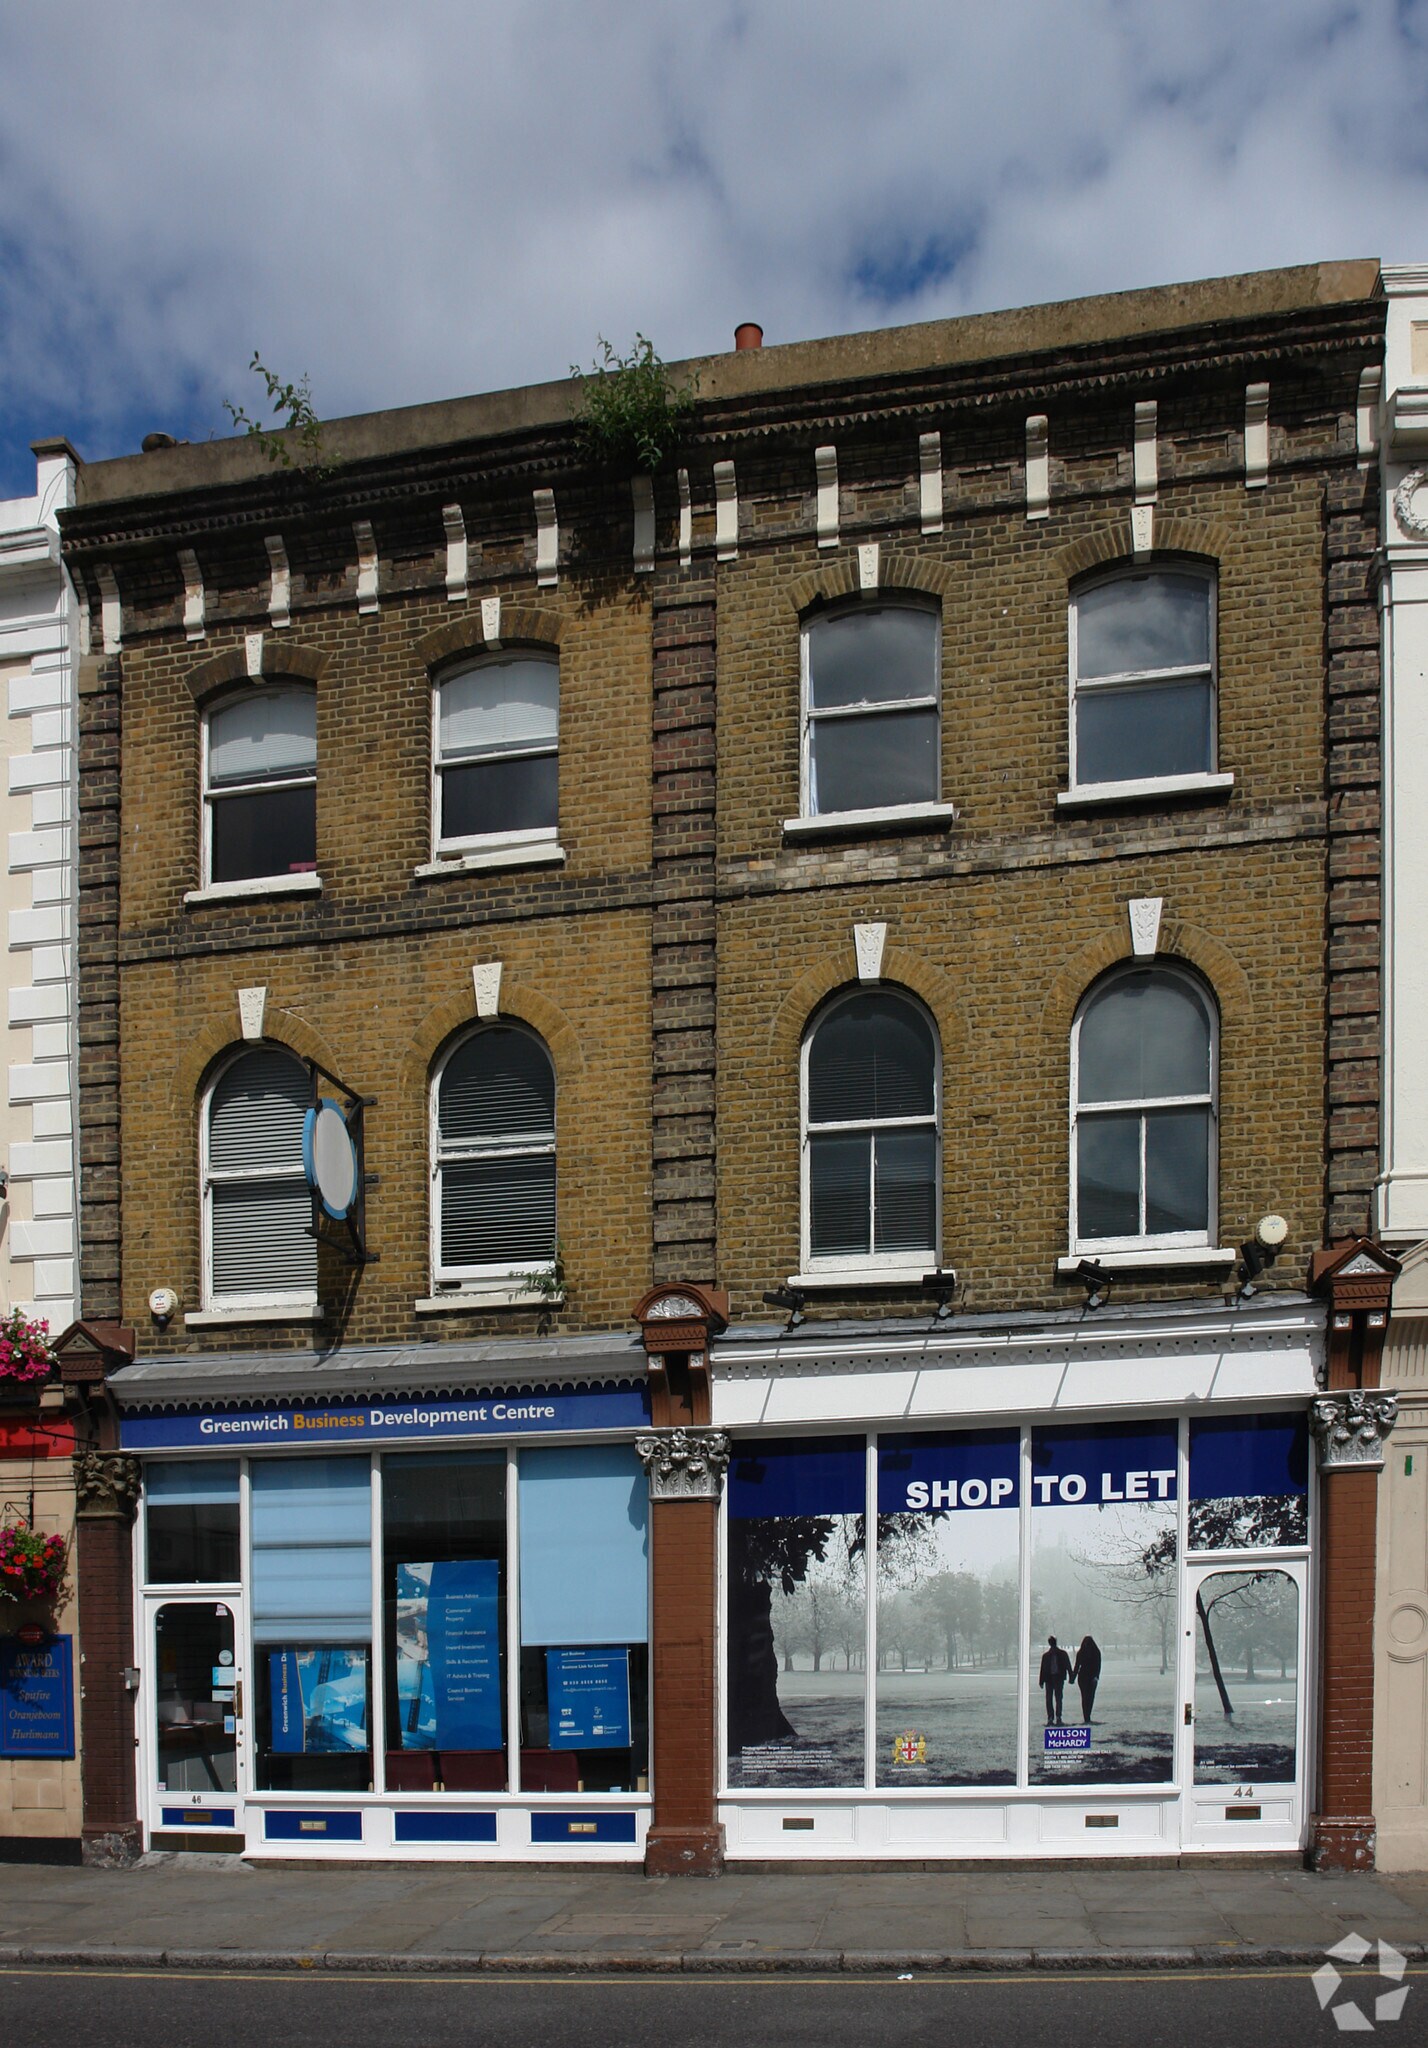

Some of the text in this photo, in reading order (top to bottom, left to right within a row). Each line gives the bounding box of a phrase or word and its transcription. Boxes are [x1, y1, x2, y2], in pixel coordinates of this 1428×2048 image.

[200, 1404, 555, 1434] Greenwich Business Development Centre
[905, 1470, 1176, 1509] SHOP TO LET
[16, 1653, 52, 1667] AWARD
[19, 1689, 51, 1702] Spitfire
[9, 1709, 61, 1722] Oranjeboom
[11, 1729, 59, 1740] Hurlimann
[1048, 1729, 1087, 1738] WILSON
[1048, 1739, 1087, 1748] McHARDY
[1233, 1786, 1253, 1797] 44
[192, 1795, 202, 1804] 46
